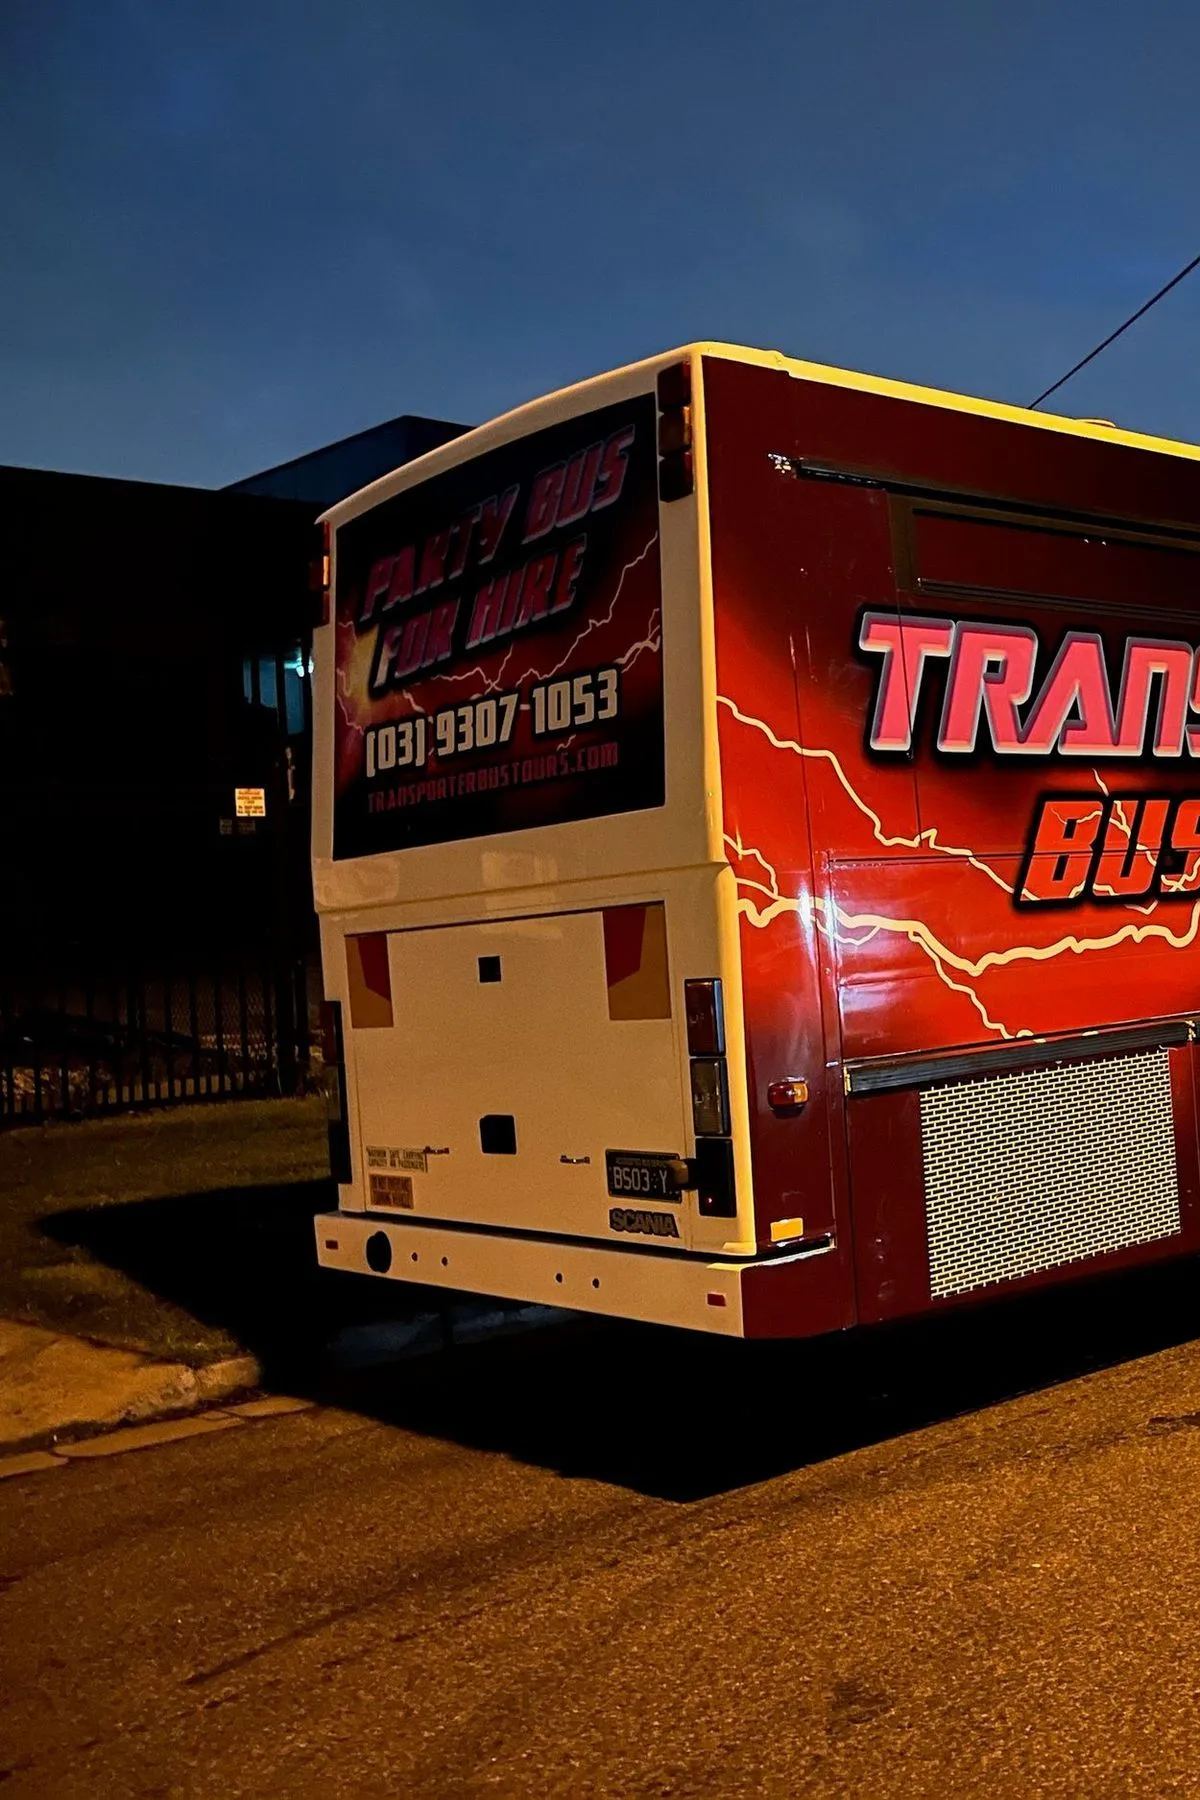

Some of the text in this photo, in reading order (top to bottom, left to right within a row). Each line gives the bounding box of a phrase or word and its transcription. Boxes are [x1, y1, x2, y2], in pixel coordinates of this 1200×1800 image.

[359, 424, 635, 622] PARTY BUS
[373, 532, 587, 688] FOR HIRE
[366, 718, 425, 777] (03)
[368, 743, 618, 813] TRANSPORTERBUSTOURS.COM
[610, 1209, 678, 1237] SCANIA
